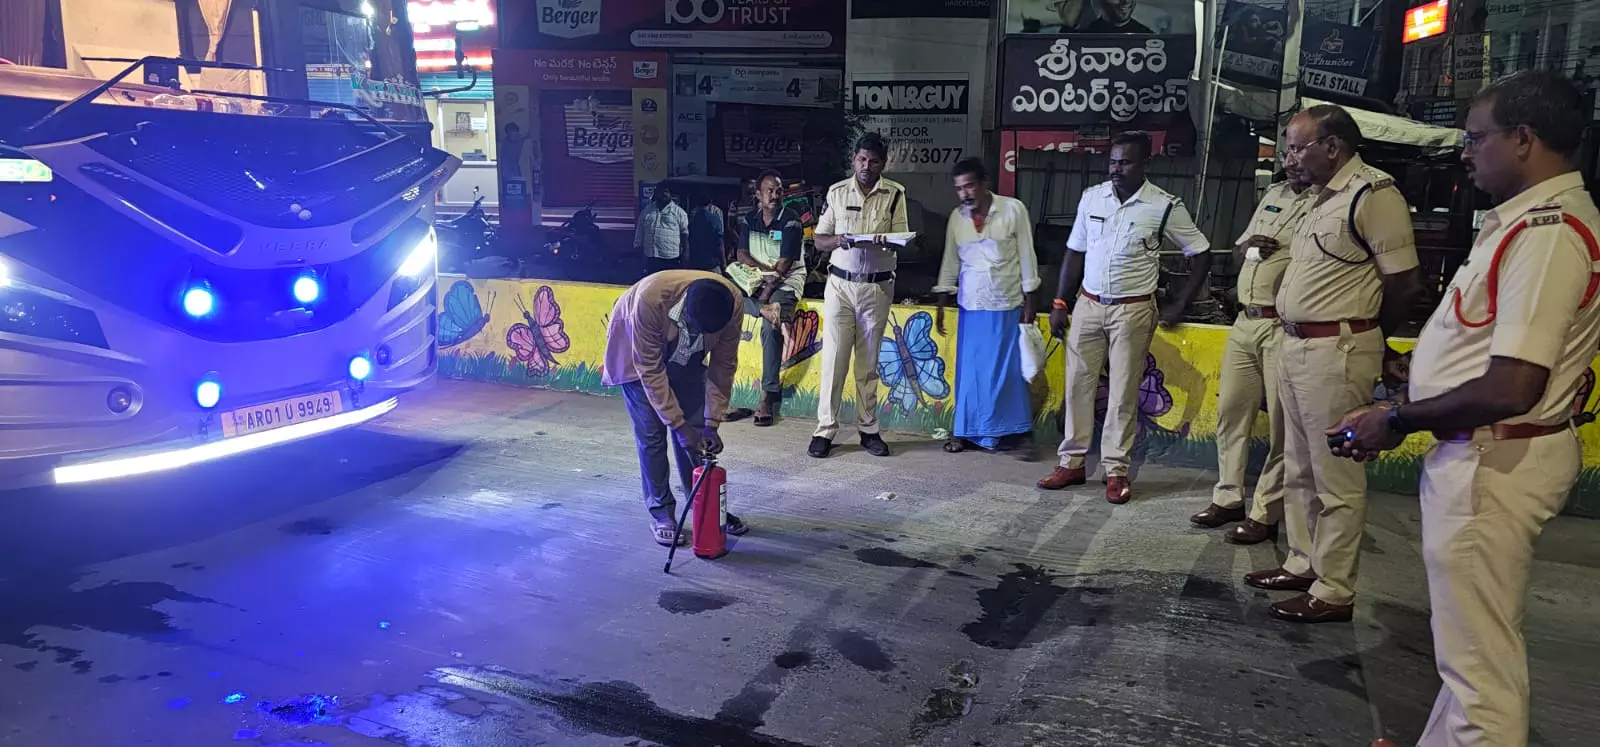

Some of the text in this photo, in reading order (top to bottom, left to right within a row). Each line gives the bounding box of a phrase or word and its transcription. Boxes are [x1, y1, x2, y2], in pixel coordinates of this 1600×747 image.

[541, 7, 598, 25] Berger
[727, 7, 791, 24] TRUST
[534, 59, 547, 68] No
[578, 60, 591, 69] No
[635, 66, 656, 75] Berger
[698, 75, 714, 95] 4
[785, 78, 801, 98] 4
[1308, 71, 1360, 94] TEA STALL
[855, 85, 966, 110] TONI&GUY
[678, 112, 704, 120] ACE
[890, 126, 929, 137] FLOOR
[731, 133, 798, 158] Berger
[246, 406, 281, 430] AR01
[286, 405, 294, 420] U
[298, 398, 331, 417] 9949
